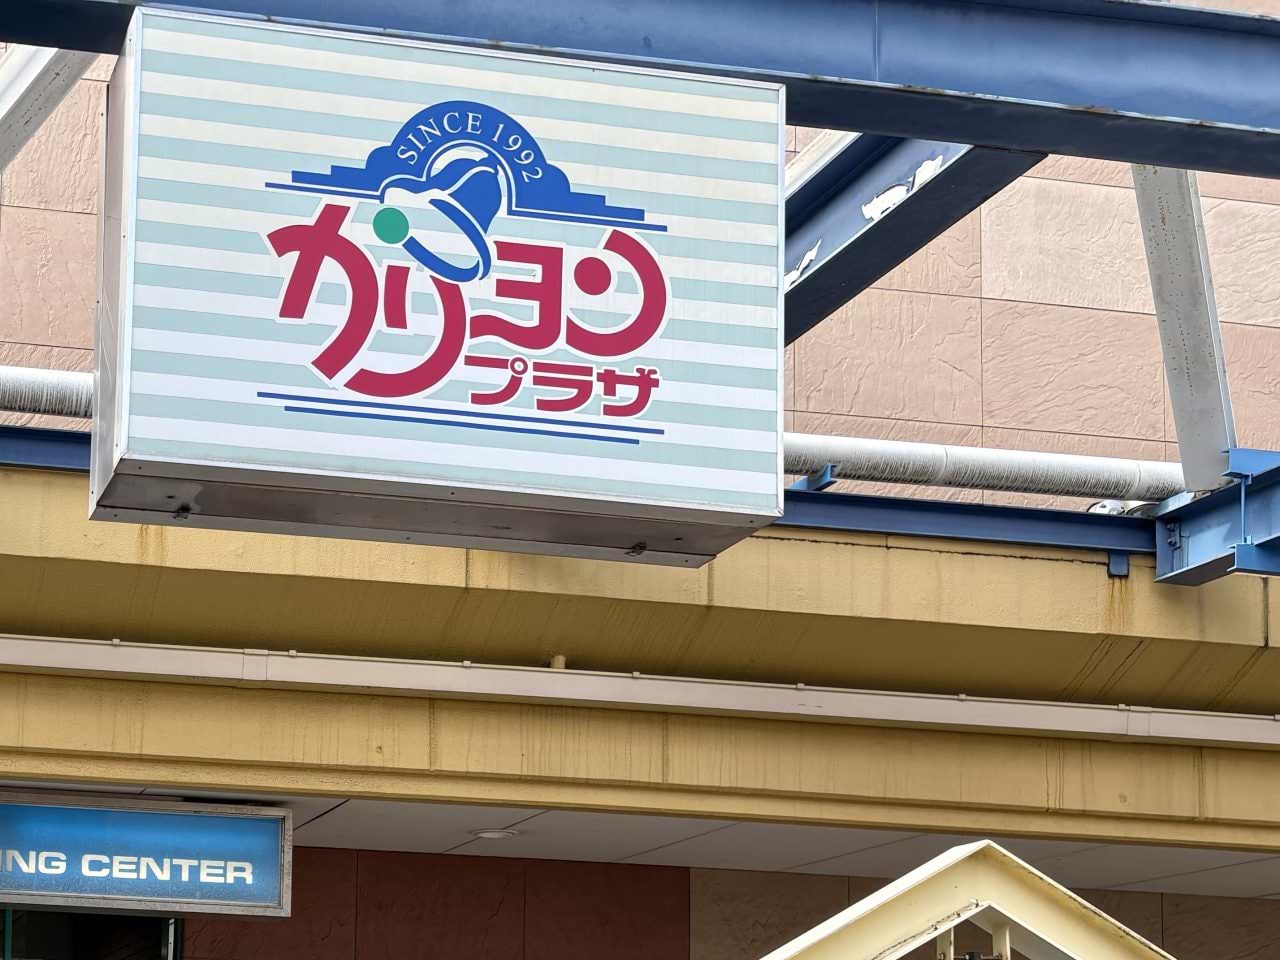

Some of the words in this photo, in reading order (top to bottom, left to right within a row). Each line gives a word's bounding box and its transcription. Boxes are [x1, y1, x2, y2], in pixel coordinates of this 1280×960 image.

[396, 111, 482, 166] SINCE
[490, 120, 543, 186] 1992
[464, 355, 660, 417] プラザ
[81, 853, 253, 885] CENTER
